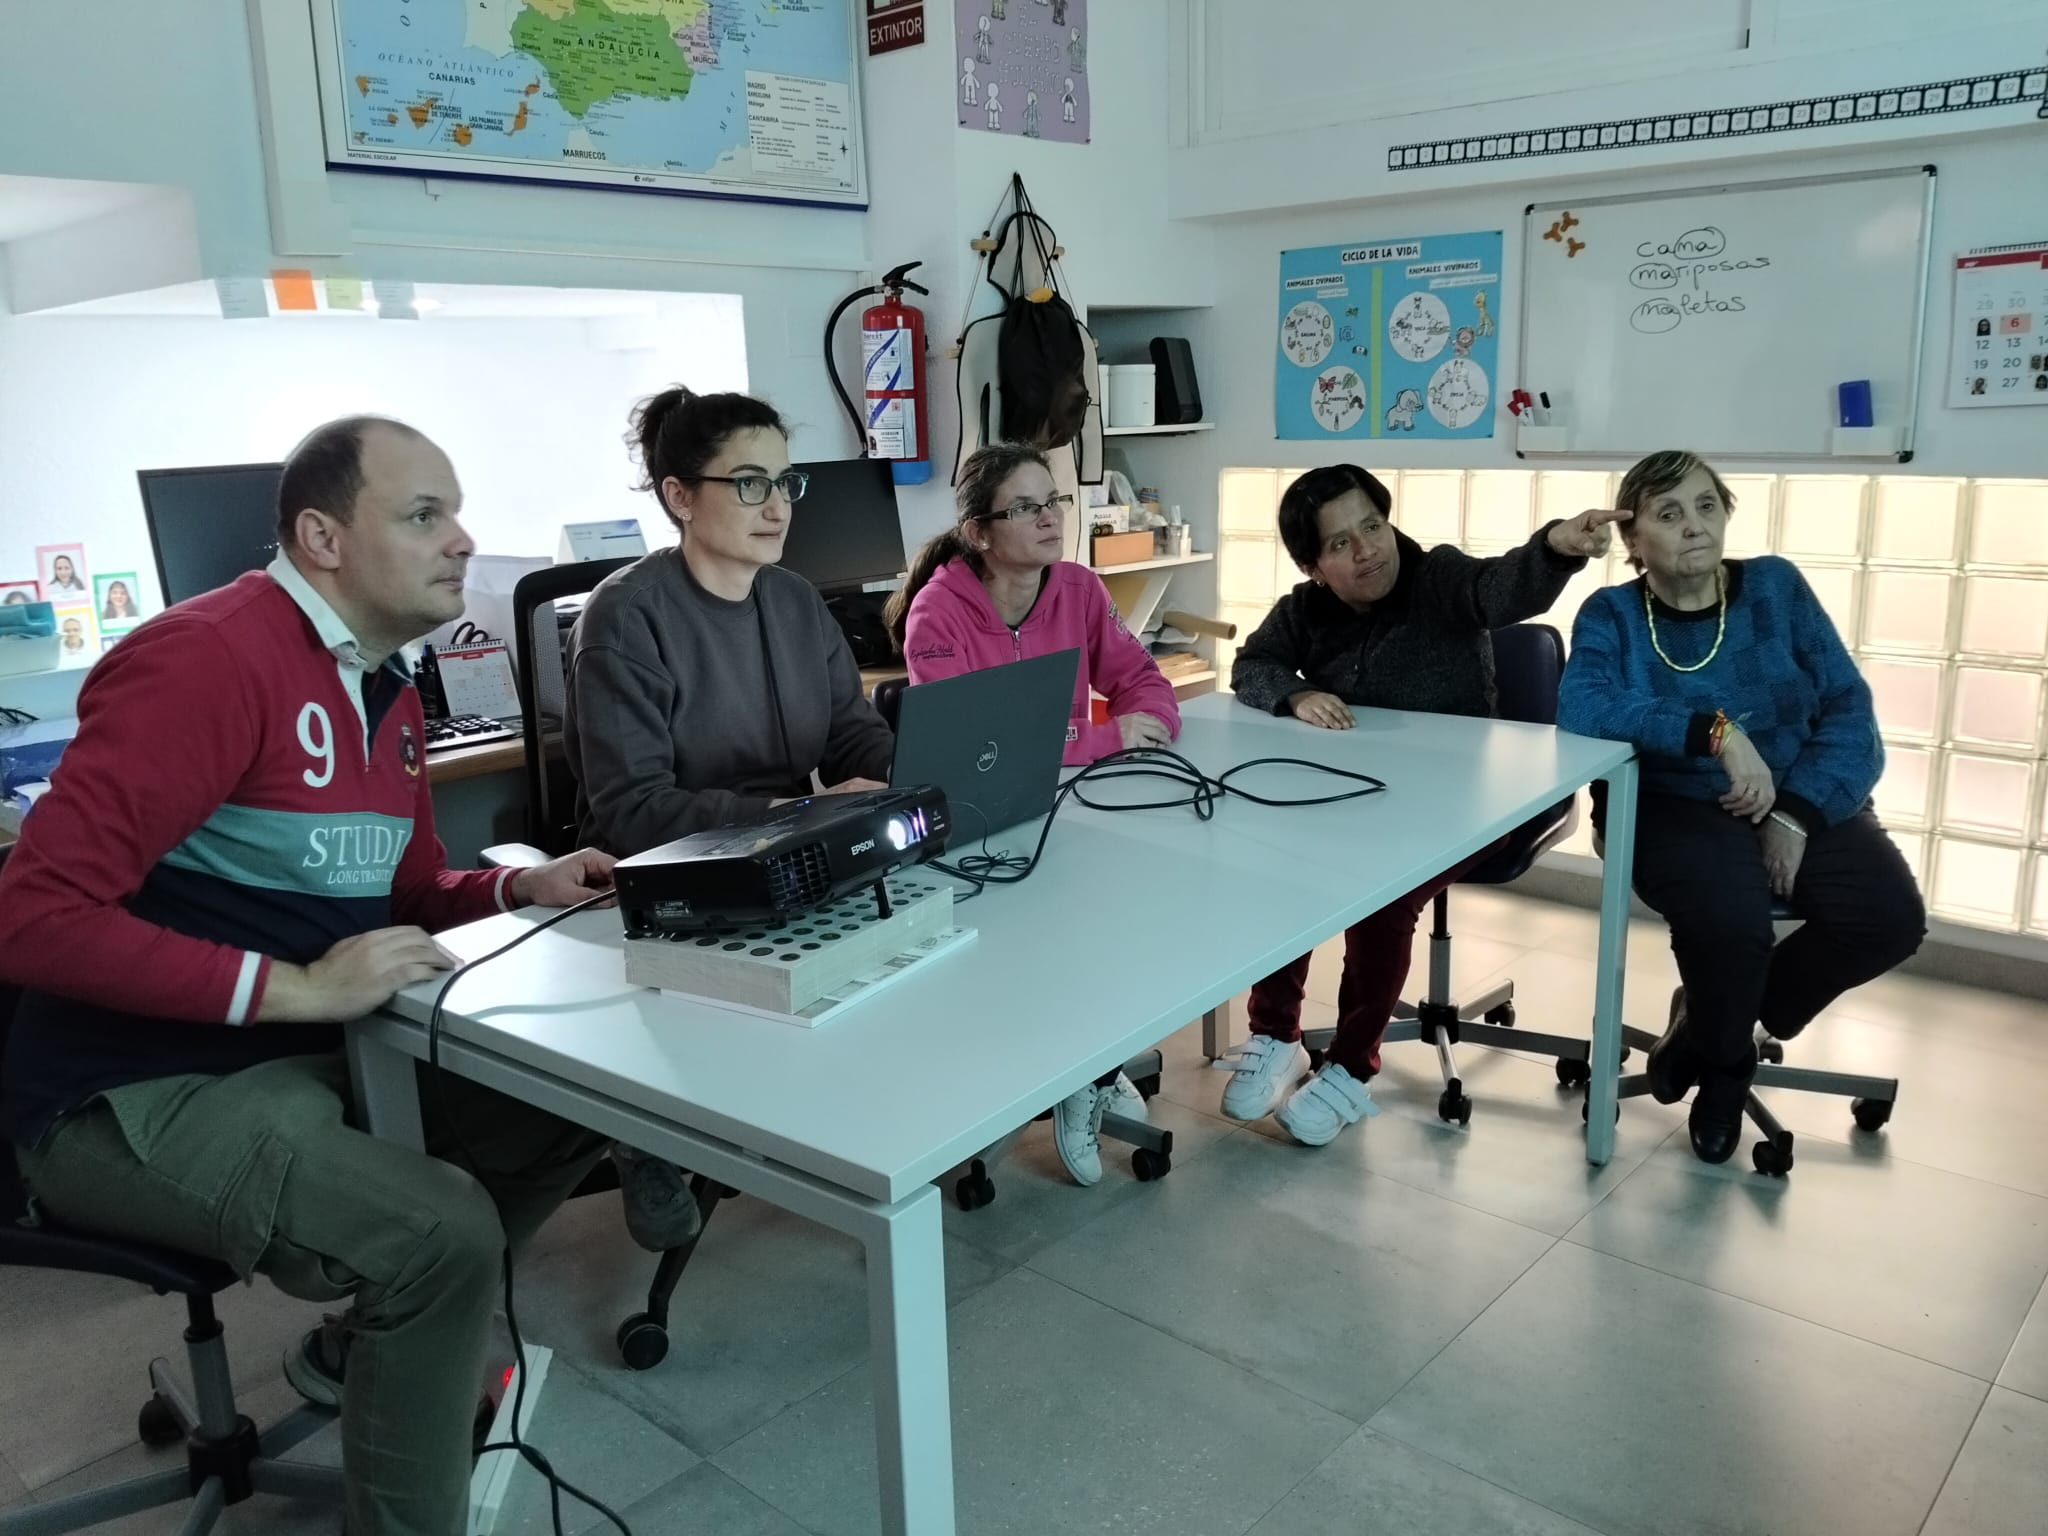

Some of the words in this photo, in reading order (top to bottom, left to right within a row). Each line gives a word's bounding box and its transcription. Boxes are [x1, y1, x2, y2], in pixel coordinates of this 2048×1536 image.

[870, 16, 922, 46] EXTINTOR
[692, 56, 718, 64] MURCIA
[428, 72, 476, 86] CANARIAS
[748, 114, 779, 123] CANTABRIA
[562, 148, 606, 161] MARRUECOS
[1342, 250, 1367, 262] CICLO
[1368, 248, 1380, 260] DE
[1381, 247, 1393, 258] LA
[1396, 245, 1419, 257] VIDA
[1637, 237, 1720, 258] cama
[1407, 264, 1441, 275] ANIMALES
[1636, 258, 1770, 290] mariposas
[1286, 278, 1314, 288] ANIMALES
[1639, 291, 1745, 317] maletas
[2010, 317, 2020, 328] 6
[1976, 339, 1990, 350] 12
[2007, 337, 2021, 348] 13
[1974, 359, 1988, 370] 19
[2003, 357, 2022, 368] 20
[2002, 377, 2020, 388] 27
[297, 701, 335, 788] 9
[979, 751, 995, 762] DELL
[850, 839, 875, 856] EPSON
[327, 870, 360, 885] LONG
